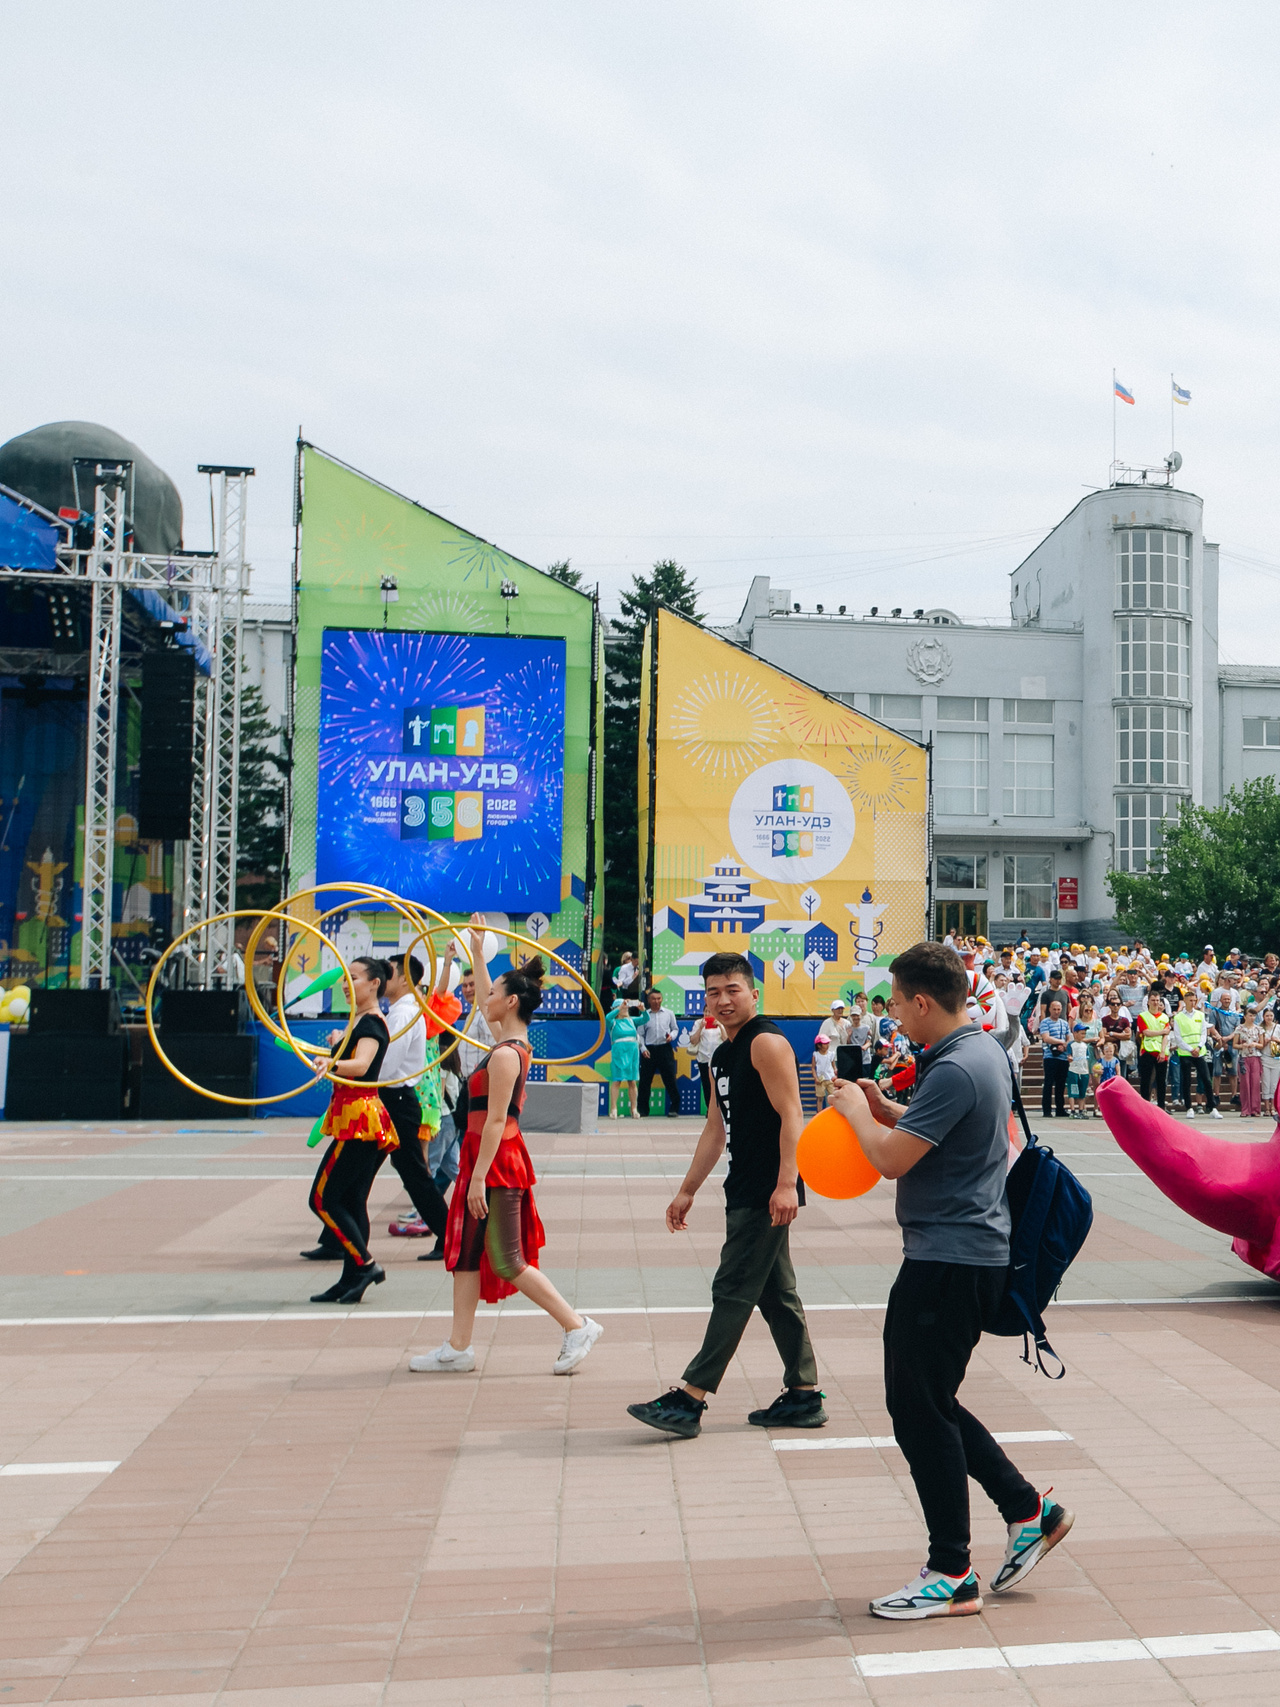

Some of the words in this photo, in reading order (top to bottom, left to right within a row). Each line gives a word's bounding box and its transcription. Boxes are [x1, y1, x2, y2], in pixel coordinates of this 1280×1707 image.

[367, 760, 518, 789] УЛАН-УДЭ
[370, 796, 397, 808] 1666
[486, 799, 517, 811] 2022
[403, 795, 481, 828] 356
[755, 815, 831, 829] УЛАН-УДЭ
